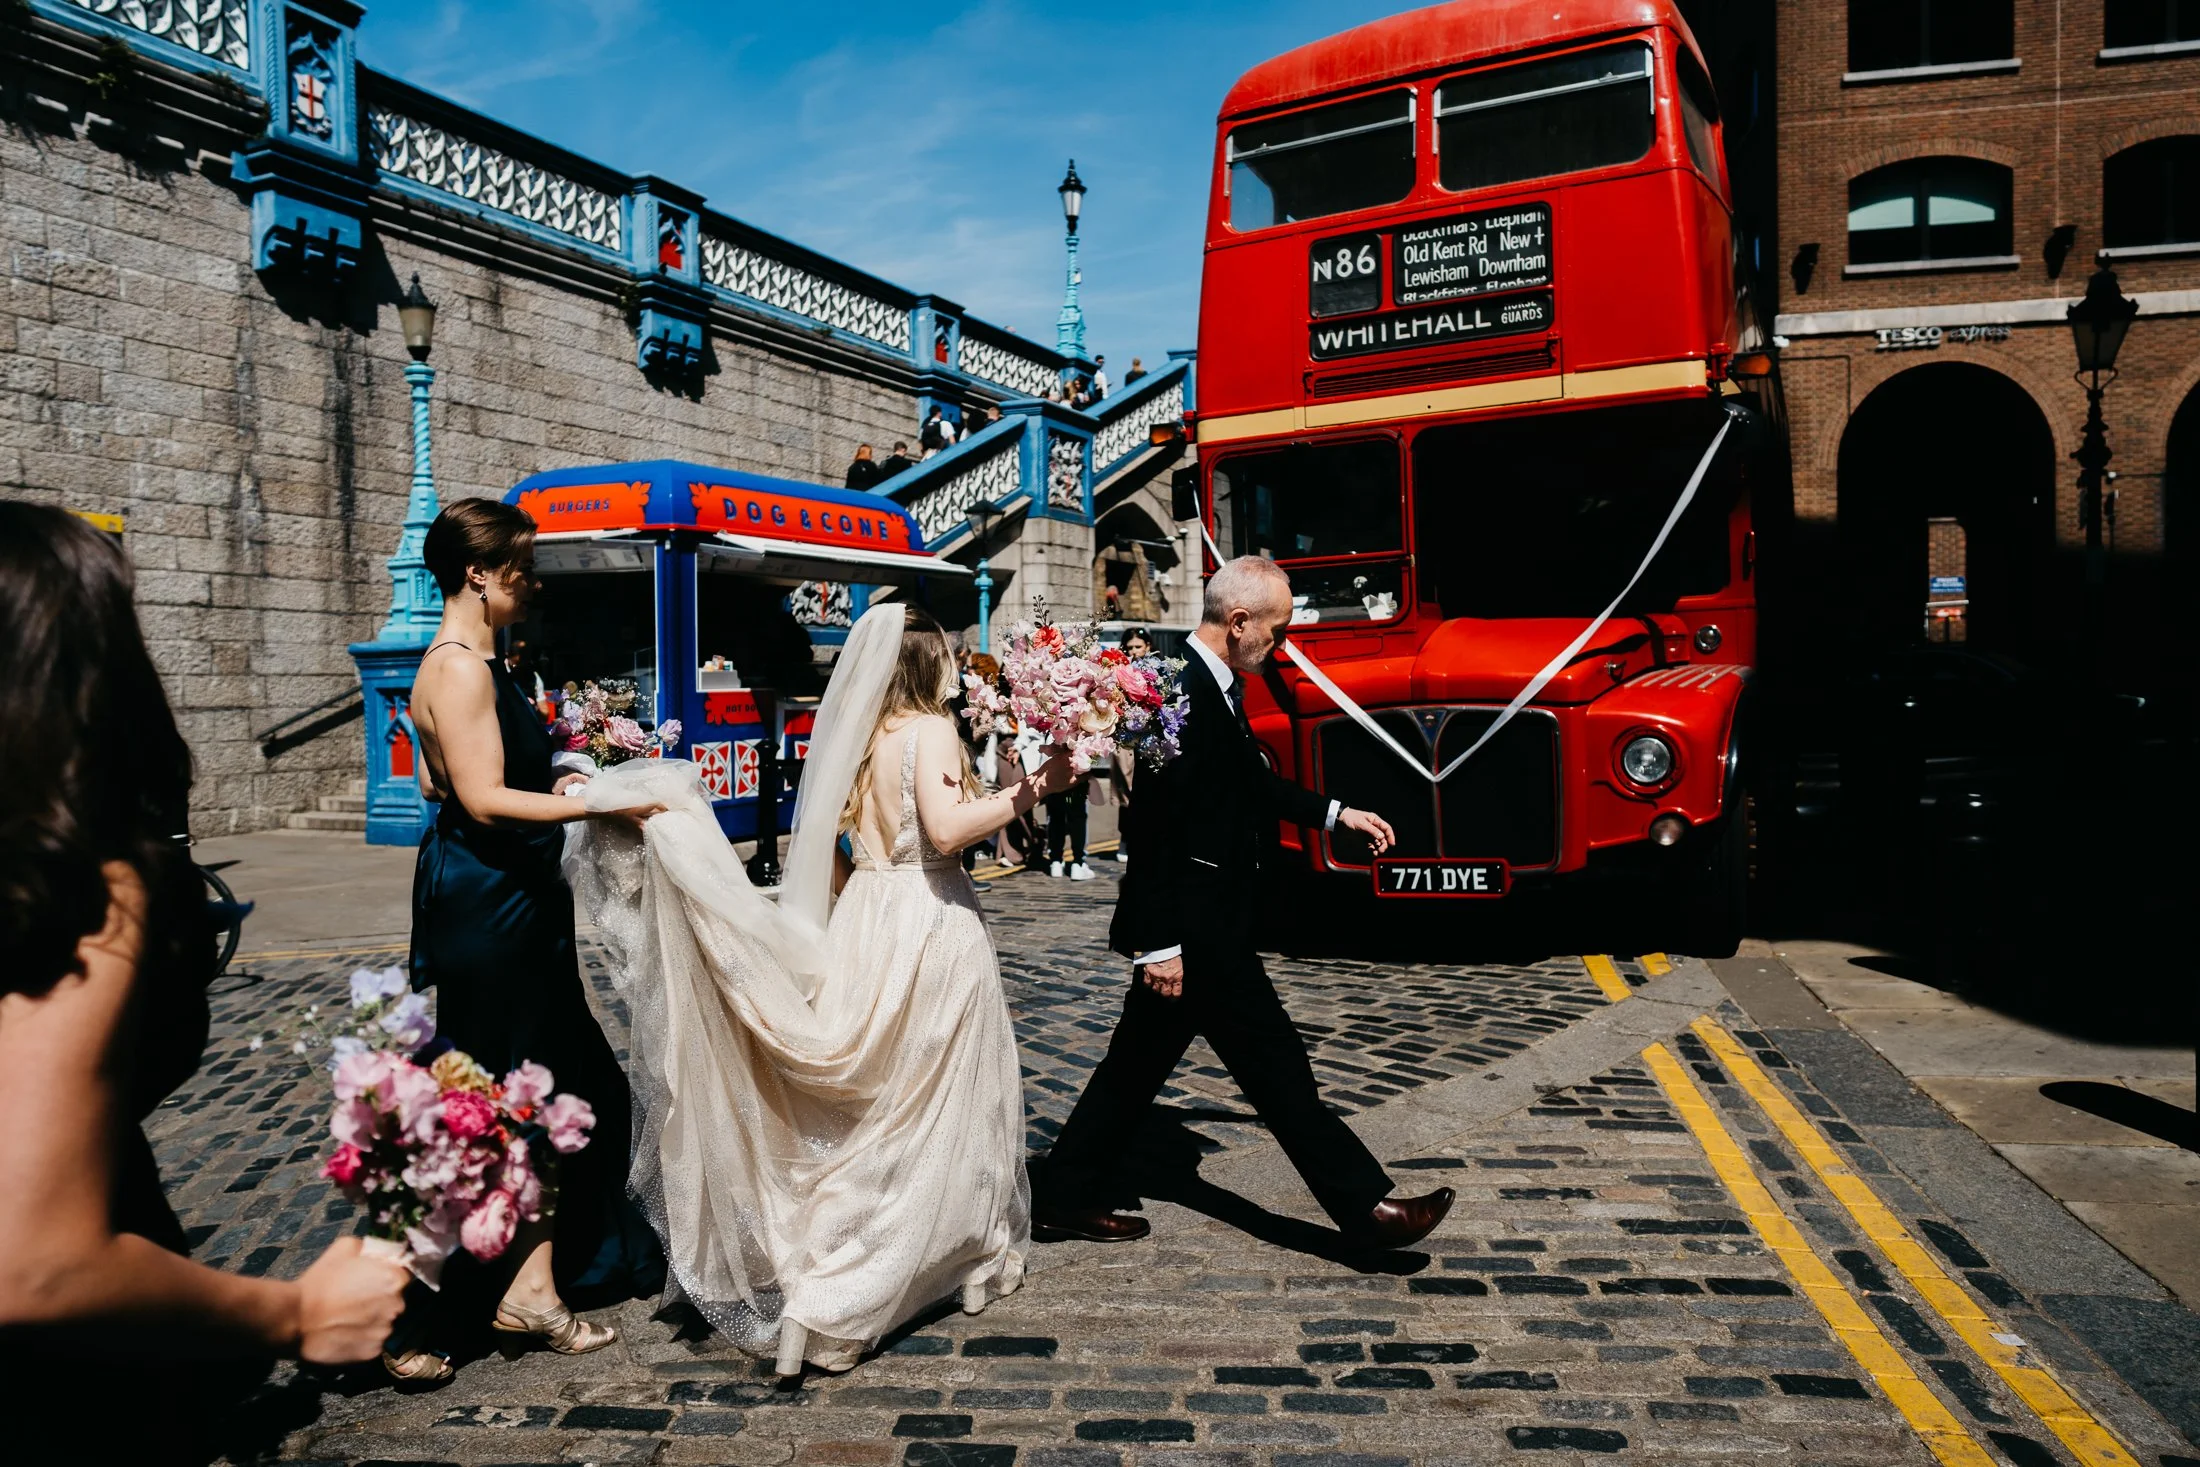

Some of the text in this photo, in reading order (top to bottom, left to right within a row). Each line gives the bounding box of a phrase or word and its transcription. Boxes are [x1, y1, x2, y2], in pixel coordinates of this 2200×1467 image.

[1312, 244, 1376, 282] N86
[1403, 243, 1428, 265] Old
[1432, 241, 1465, 261] Kent
[1468, 234, 1487, 256] Rd
[1499, 231, 1531, 251] New
[1404, 253, 1546, 288] Lewisham Downham
[1317, 307, 1543, 351] WHITEHALL GUARDS
[1875, 325, 2013, 342] TESCO express
[549, 498, 610, 515] BURGERS
[722, 497, 787, 527] DOG
[821, 512, 889, 541] CONE
[725, 703, 741, 712] HOT
[1391, 867, 1488, 891] 771 DYE
